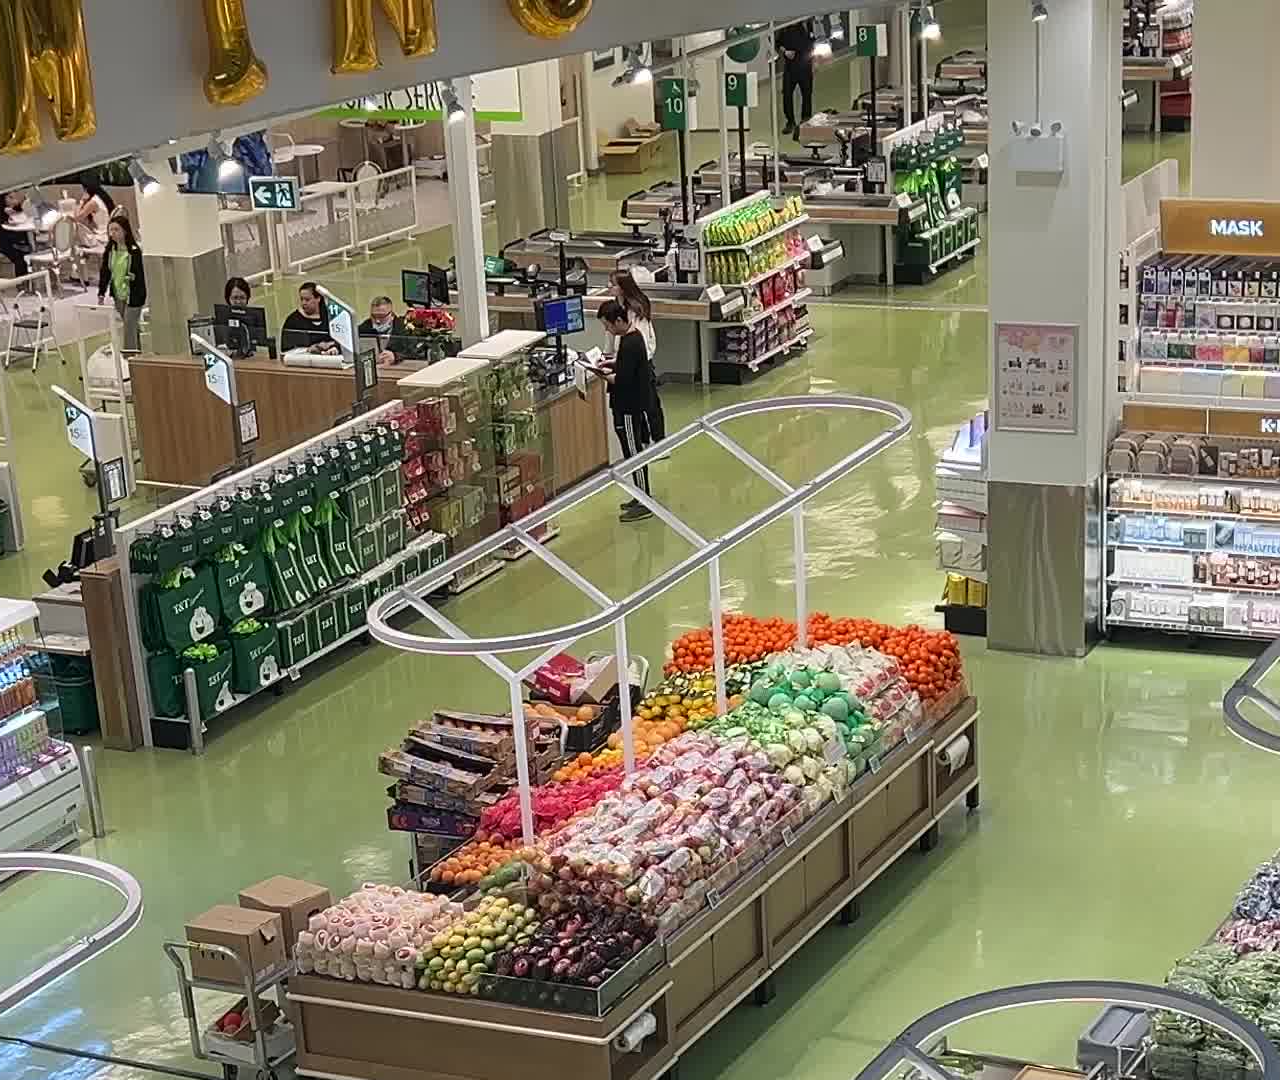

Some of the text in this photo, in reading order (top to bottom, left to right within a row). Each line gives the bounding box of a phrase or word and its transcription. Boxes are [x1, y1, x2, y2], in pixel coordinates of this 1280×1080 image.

[858, 27, 868, 42] 8
[727, 74, 738, 90] 9
[664, 98, 684, 114] 10
[1210, 219, 1265, 237] MASK
